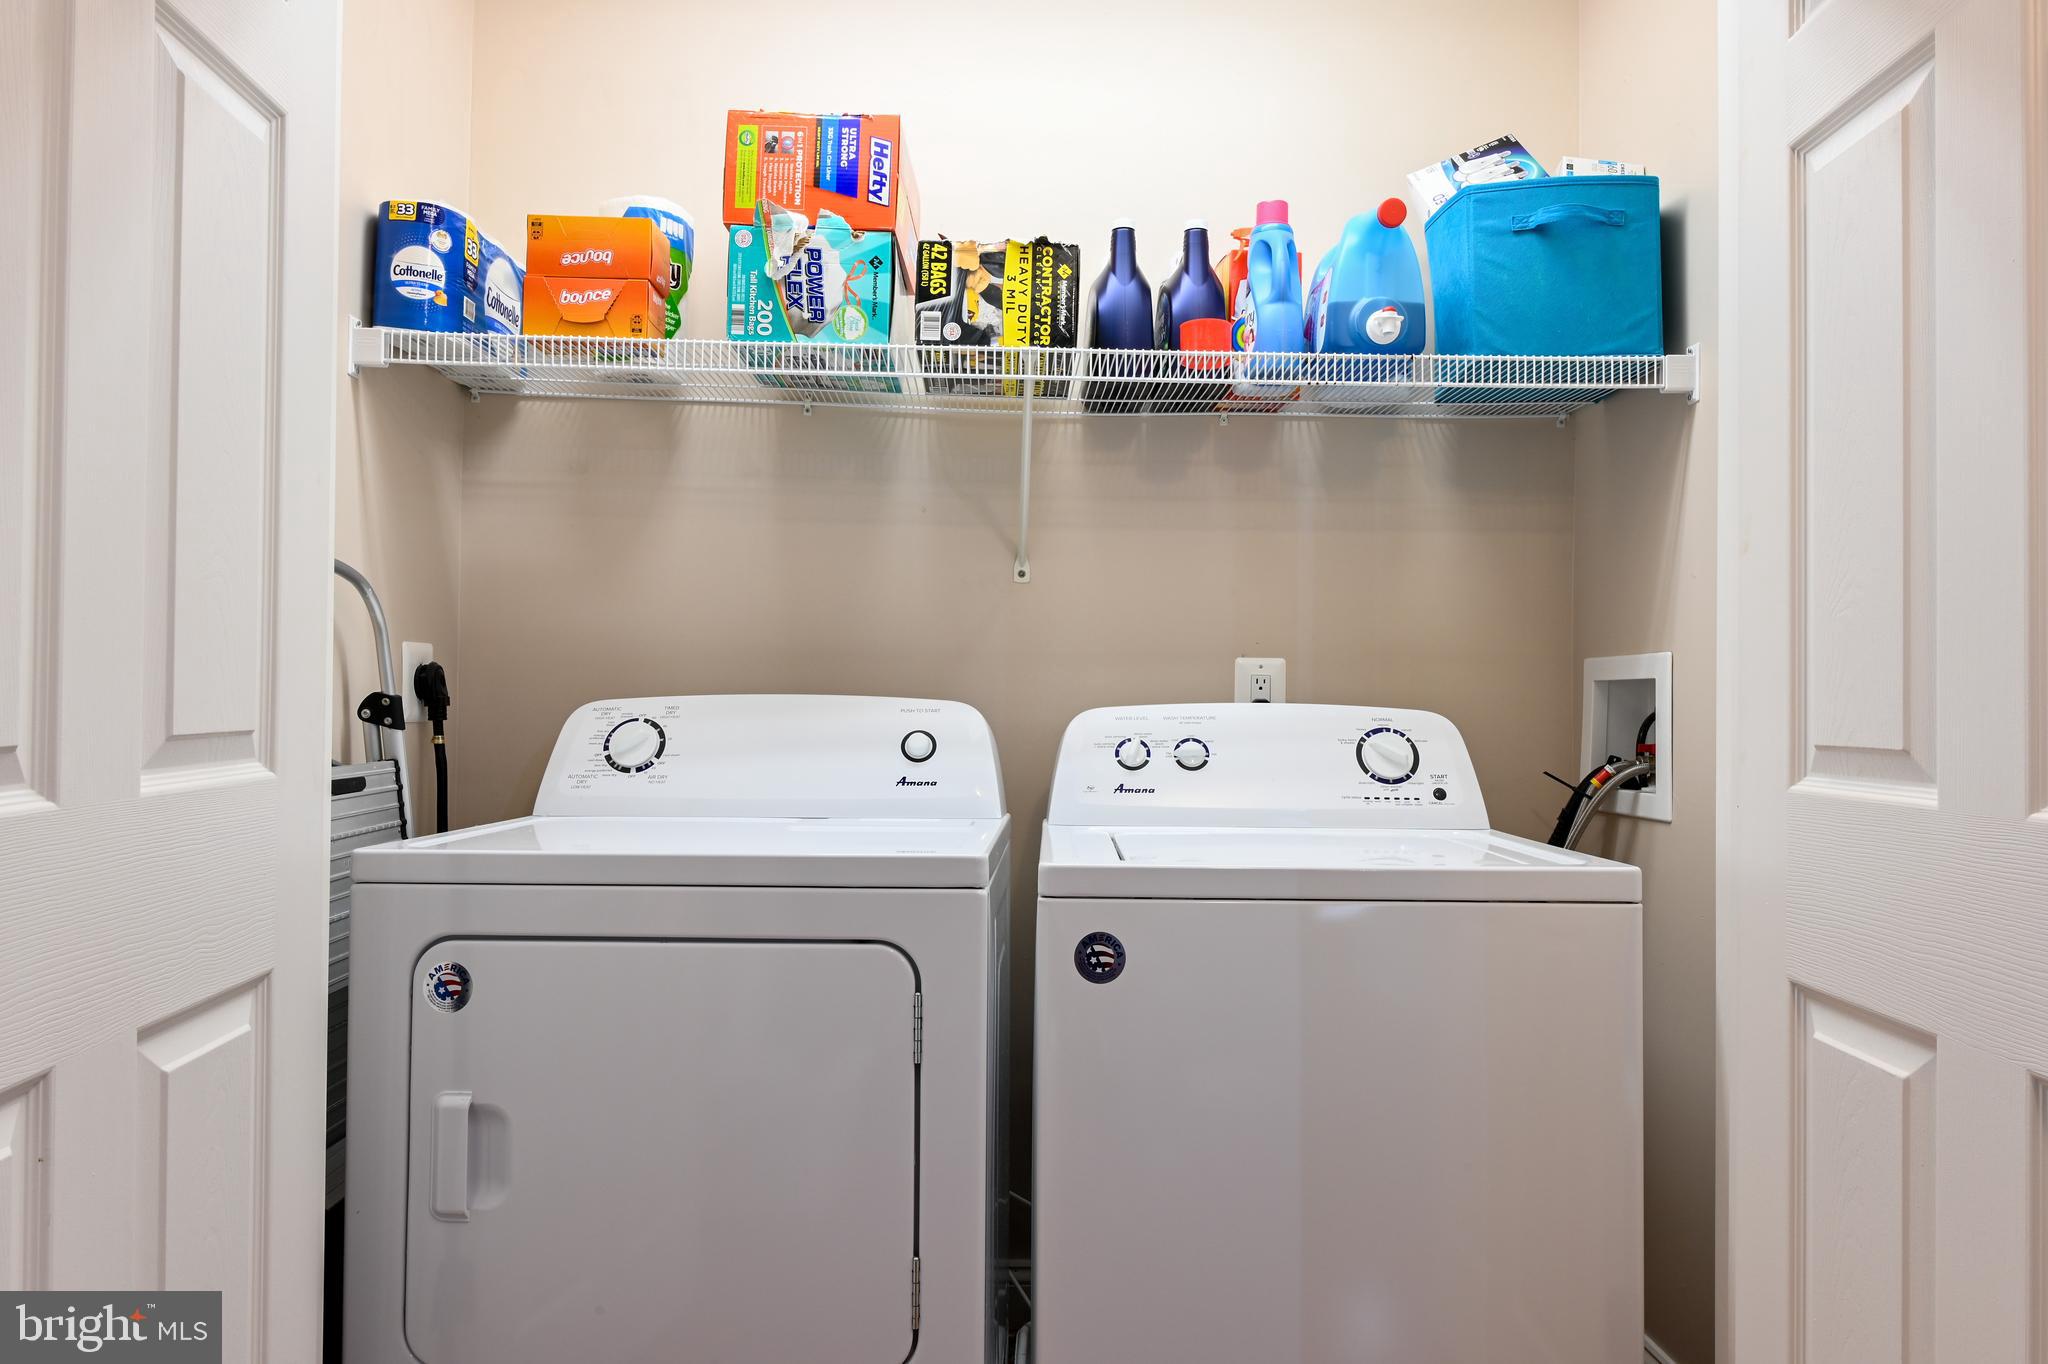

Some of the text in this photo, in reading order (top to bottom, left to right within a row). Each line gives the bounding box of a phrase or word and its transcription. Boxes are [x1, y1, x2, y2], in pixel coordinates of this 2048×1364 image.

[840, 128, 849, 167] STRONG
[848, 128, 857, 160] ULTRA
[794, 150, 802, 205] PROTECTION
[868, 142, 889, 201] Hefty
[397, 203, 415, 215] 33
[467, 238, 478, 260] 33
[562, 250, 612, 264] bounce
[393, 265, 443, 281] Cottonelle
[930, 243, 948, 295] 42 BAGS
[560, 289, 611, 304] bounce
[804, 248, 825, 323] POWER
[1017, 246, 1028, 344] HEAVY DUTY
[1040, 246, 1053, 345] CONTRACTOR
[486, 286, 520, 327] Cottonelle
[749, 285, 757, 314] Kitchen
[1006, 289, 1016, 314] MIL
[748, 316, 756, 335] Bags
[757, 300, 773, 336] 200
[896, 776, 937, 786] Amana
[1114, 784, 1155, 794] Amana
[1081, 934, 1123, 958] AMERICA
[429, 963, 470, 985] AMERICA
